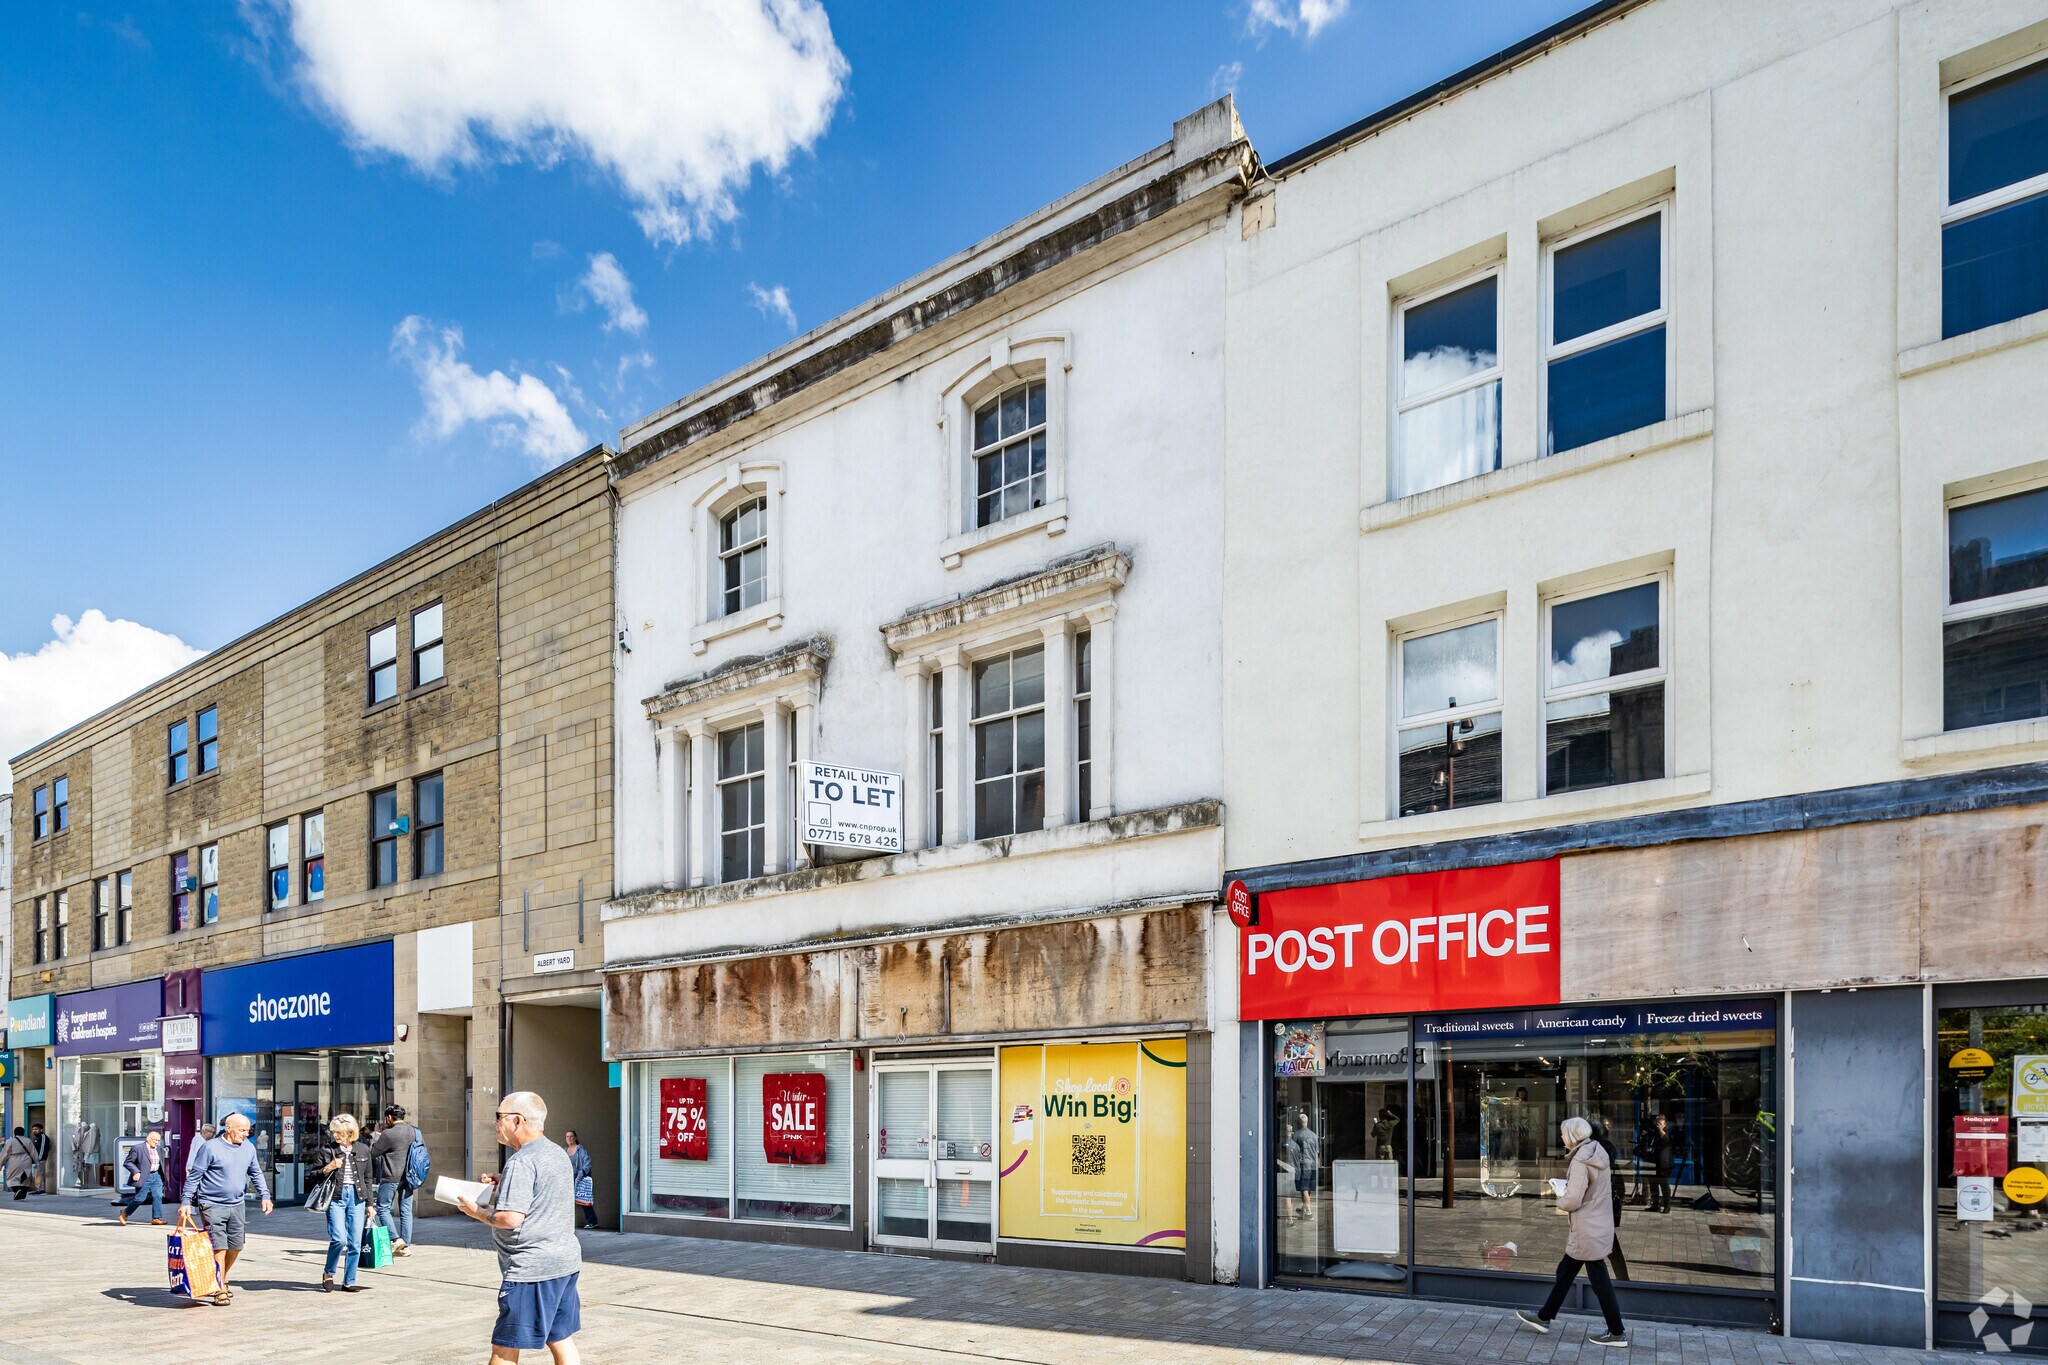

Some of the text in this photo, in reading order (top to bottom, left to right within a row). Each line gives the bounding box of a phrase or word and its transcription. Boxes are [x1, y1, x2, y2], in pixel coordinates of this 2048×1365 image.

[815, 766, 890, 785] RETAIL UNIT
[809, 779, 896, 808] TO LET
[837, 821, 898, 834] www.cnprop.uk
[808, 828, 899, 848] 07715 678 426
[1234, 888, 1248, 904] POST
[1232, 900, 1250, 918] OFFICE
[1248, 905, 1550, 976] POST OFFICE
[537, 956, 571, 967] ALBERT YARD
[249, 991, 331, 1024] shoezone
[10, 1012, 46, 1034] Poundland
[71, 1009, 108, 1026] forget me not
[1423, 1010, 1763, 1034] Traditional sweets American candy Freeze dried sweets
[71, 1023, 117, 1041] children's hospice
[1276, 1059, 1324, 1072] HALAL
[780, 1087, 808, 1102] Winter
[1055, 1076, 1115, 1099] Shop Local
[771, 1103, 816, 1131] SALE
[1043, 1094, 1087, 1118] Win
[1093, 1094, 1138, 1124] Big!
[677, 1132, 695, 1143] OFF
[1051, 1187, 1128, 1200] Supporting and celebrating
[1065, 1197, 1090, 1205] fantastic
[1090, 1199, 1123, 1207] businesses
[1078, 1206, 1088, 1214] the
